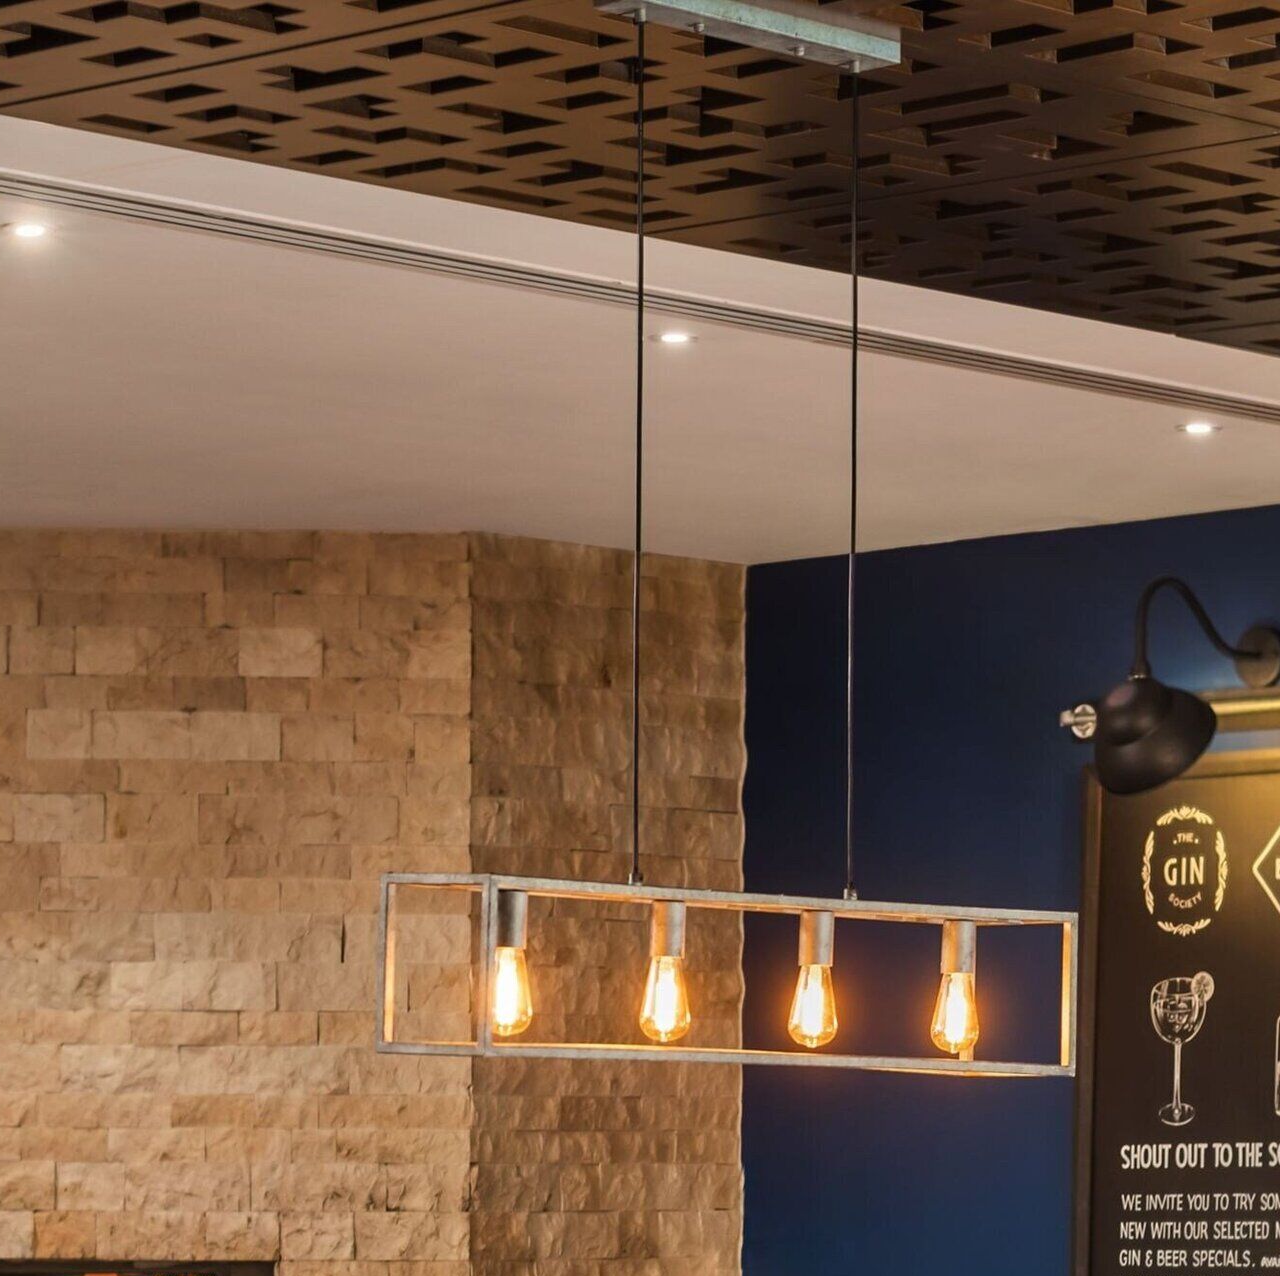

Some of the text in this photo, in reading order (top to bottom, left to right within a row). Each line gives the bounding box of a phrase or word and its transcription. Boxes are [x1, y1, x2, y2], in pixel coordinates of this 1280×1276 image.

[1176, 832, 1194, 843] THE
[1163, 856, 1205, 886] GIN
[1168, 891, 1202, 909] SOCIETY
[1120, 1143, 1172, 1170] SHOUT
[1175, 1142, 1209, 1169] OUT
[1212, 1142, 1233, 1168] TO
[1235, 1141, 1264, 1168] THE
[1121, 1193, 1142, 1211] WE
[1145, 1193, 1183, 1211] INVITE
[1186, 1193, 1210, 1211] YOU
[1213, 1193, 1229, 1211] TO
[1232, 1192, 1256, 1211] TRY
[1120, 1221, 1147, 1240] NEW
[1150, 1221, 1181, 1239] WITH
[1183, 1220, 1209, 1240] OUR
[1213, 1220, 1270, 1240] SELECTED
[1119, 1249, 1141, 1267] GIN
[1145, 1249, 1153, 1267] &
[1156, 1249, 1188, 1267] BEER
[1192, 1249, 1256, 1268] SPECIALS.
